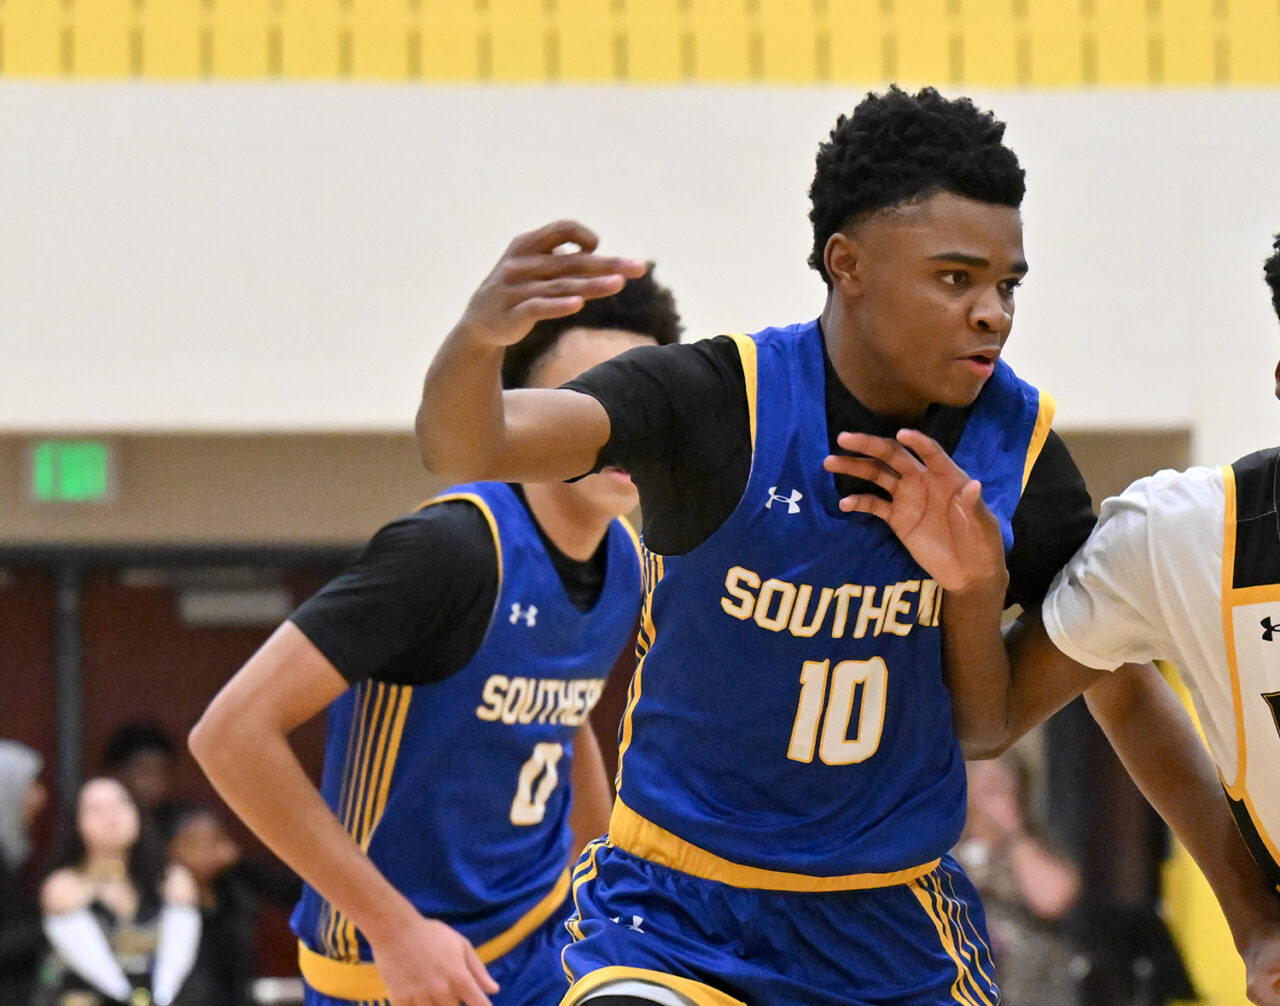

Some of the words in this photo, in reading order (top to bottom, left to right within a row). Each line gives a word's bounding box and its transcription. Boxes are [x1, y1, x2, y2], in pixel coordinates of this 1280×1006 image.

[721, 565, 944, 639] SOUTHE
[787, 656, 888, 765] 10
[510, 742, 563, 826] 0
